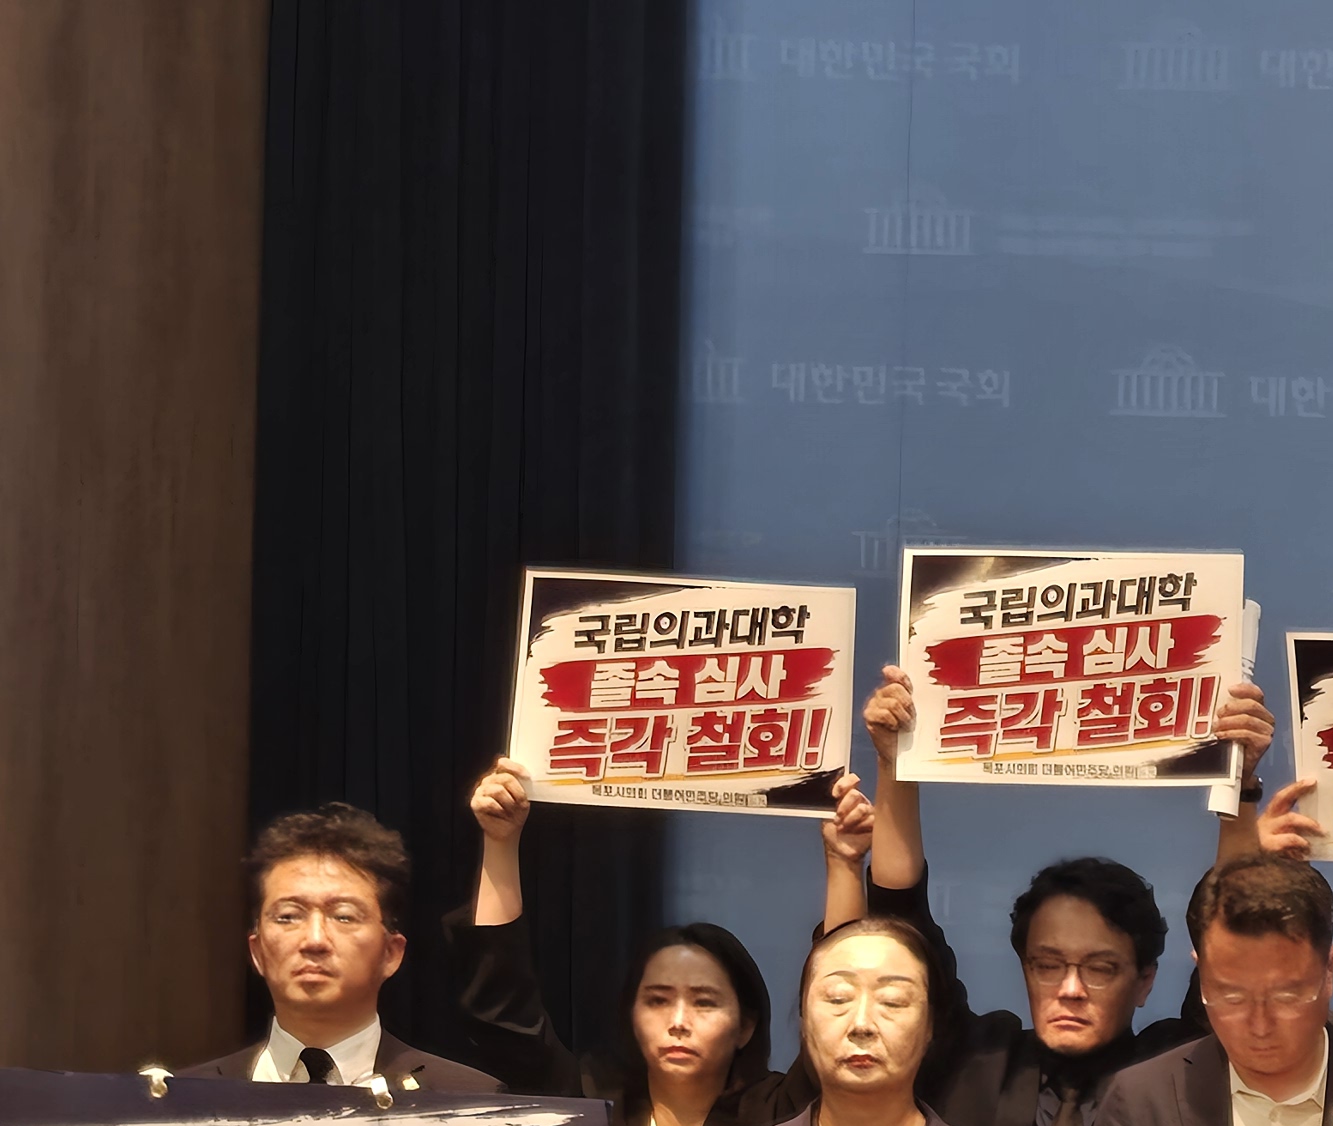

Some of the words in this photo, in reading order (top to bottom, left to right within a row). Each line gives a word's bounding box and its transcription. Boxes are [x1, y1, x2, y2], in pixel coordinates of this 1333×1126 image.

[574, 604, 810, 653] 국립의과대학
[960, 572, 1197, 628] 국립의과대학
[589, 664, 685, 708] 졸속
[694, 655, 786, 701] 심사
[980, 634, 1069, 684] 졸속
[1083, 621, 1175, 672] 심사
[549, 716, 672, 776] 즉각
[685, 708, 824, 769] 철회!
[938, 690, 1064, 756] 즉각
[1077, 677, 1219, 746] 철회!
